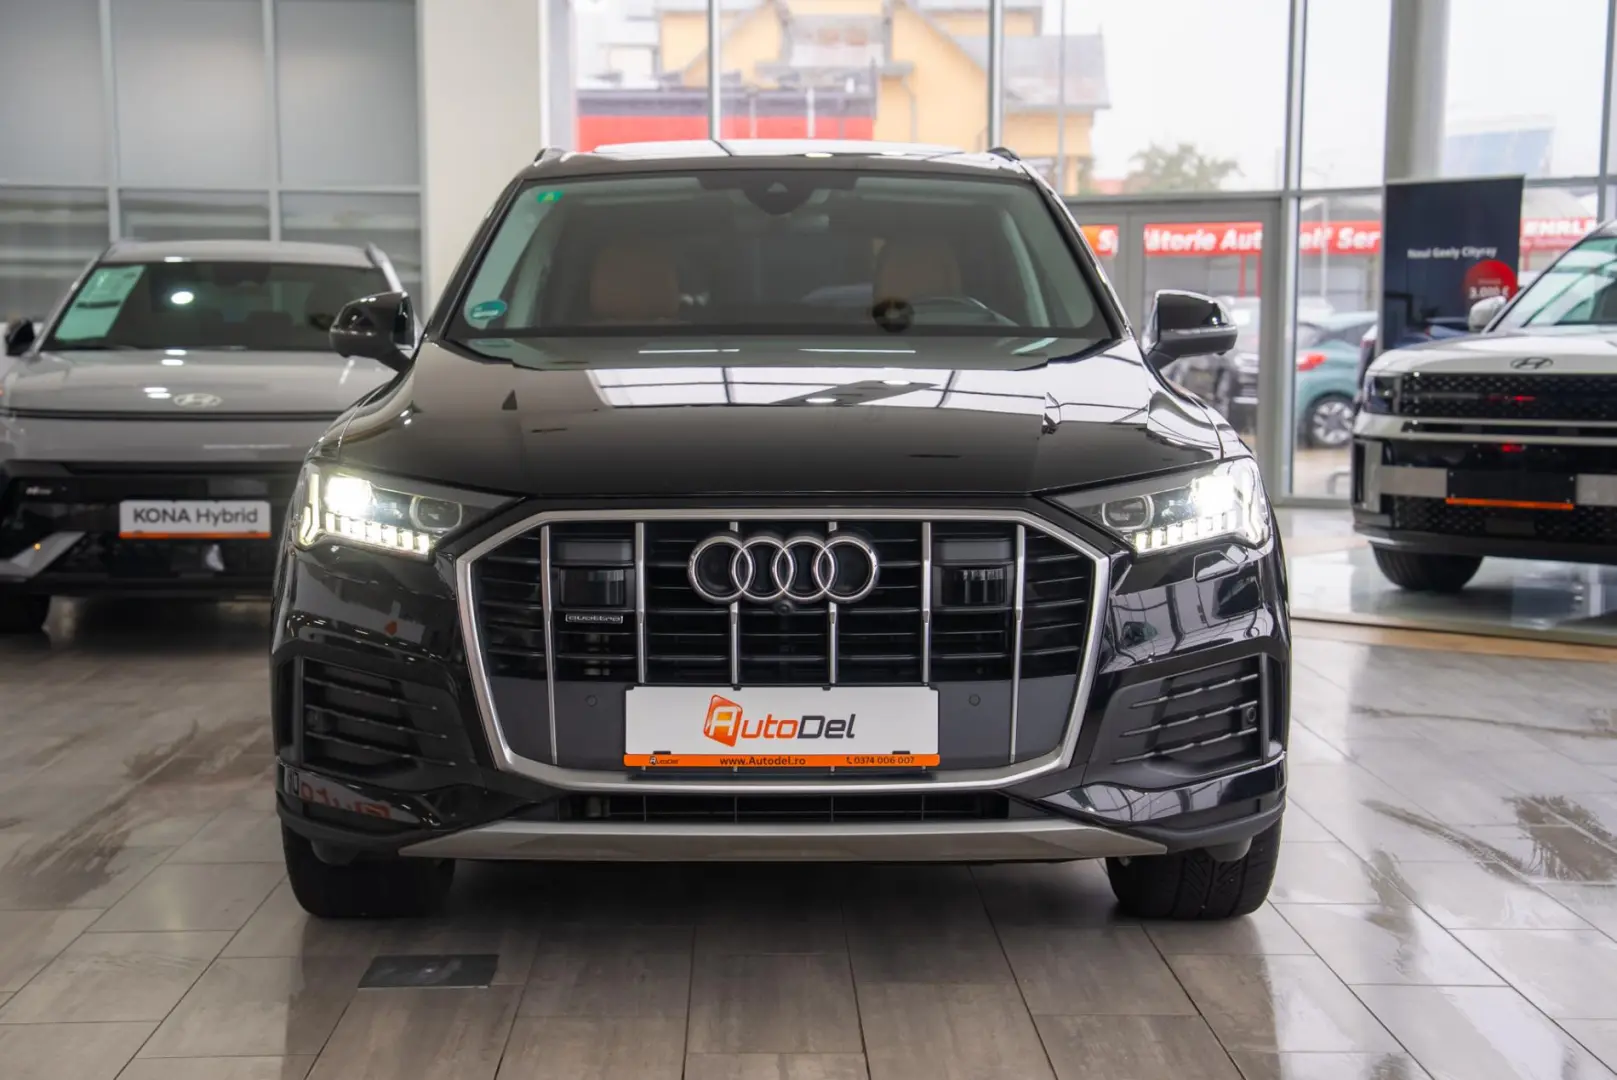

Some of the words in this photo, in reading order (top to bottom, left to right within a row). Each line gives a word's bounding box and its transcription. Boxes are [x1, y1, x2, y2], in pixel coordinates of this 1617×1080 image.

[1337, 226, 1381, 250] Ser
[1433, 247, 1459, 260] Geely
[133, 508, 191, 523] KONA
[196, 508, 258, 526] Hybrid
[703, 694, 856, 747] AutoDel
[720, 757, 806, 765] www.Autodel.ro
[854, 756, 875, 764] 0374
[878, 756, 896, 764] 006
[898, 756, 915, 764] 007
